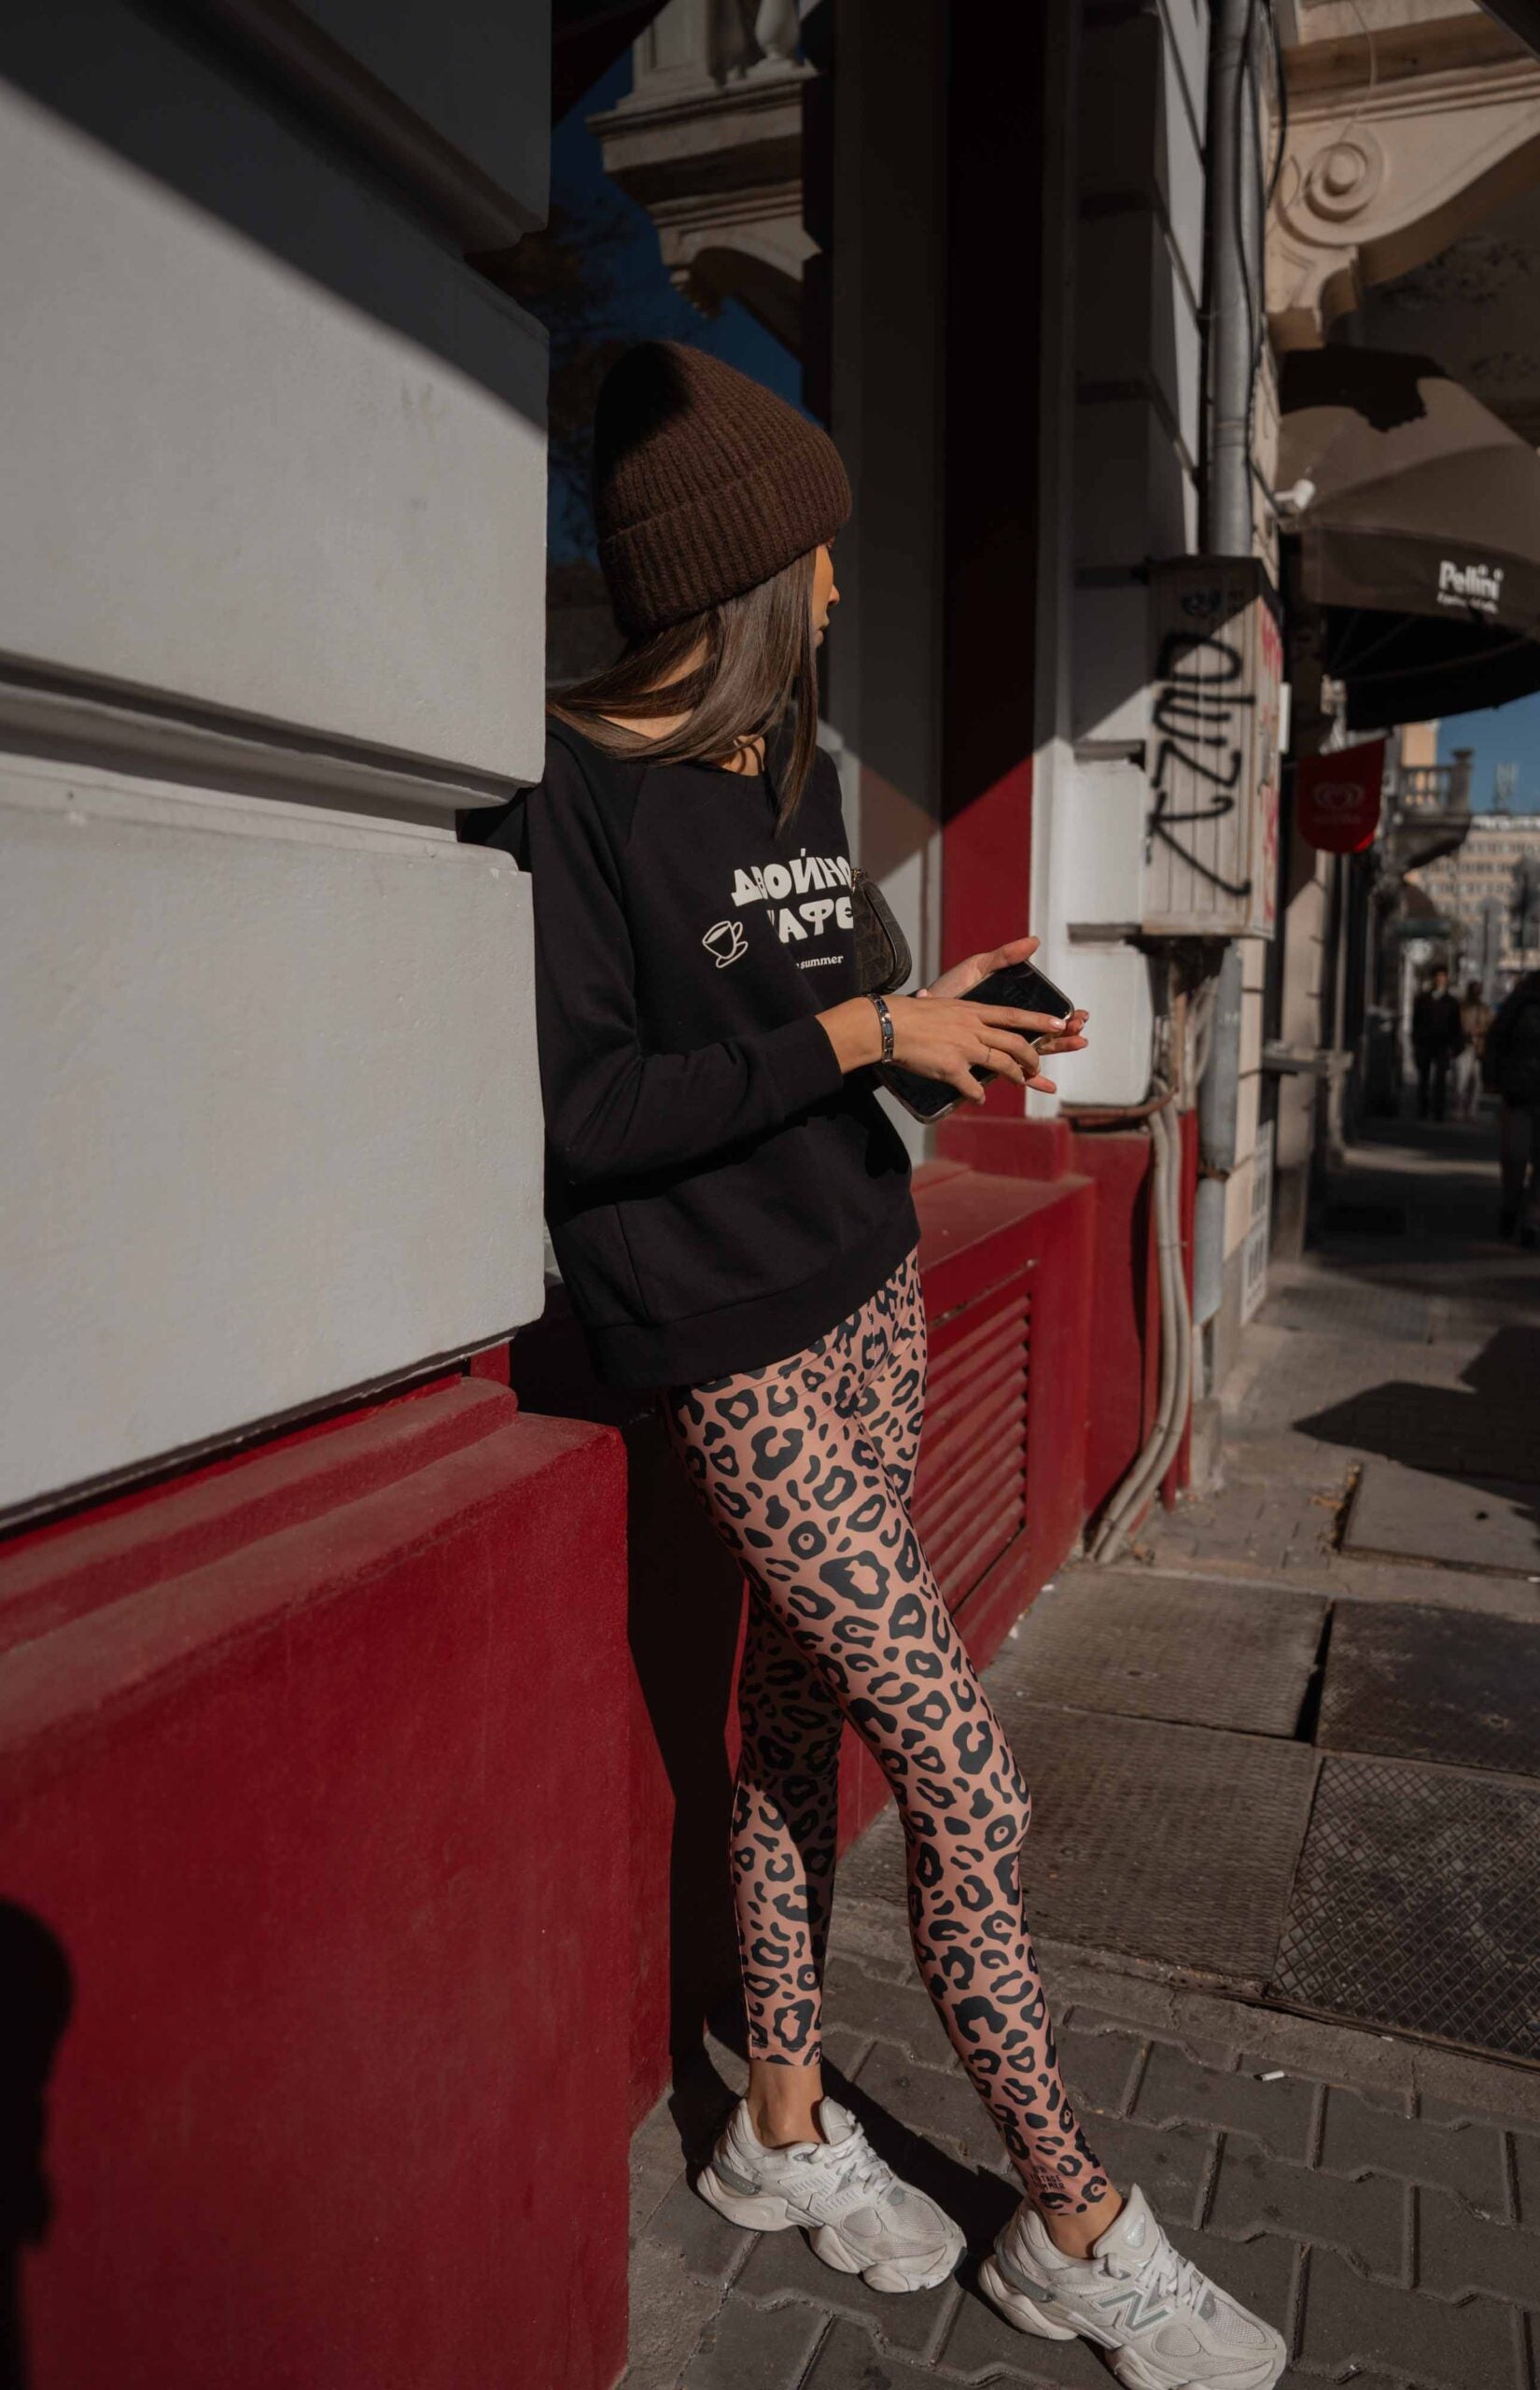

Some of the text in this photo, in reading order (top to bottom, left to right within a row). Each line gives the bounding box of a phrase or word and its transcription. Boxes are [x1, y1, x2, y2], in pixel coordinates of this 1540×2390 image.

[1438, 560, 1504, 600] Pellini
[766, 896, 854, 944] АФЕ
[800, 955, 844, 969] summer
